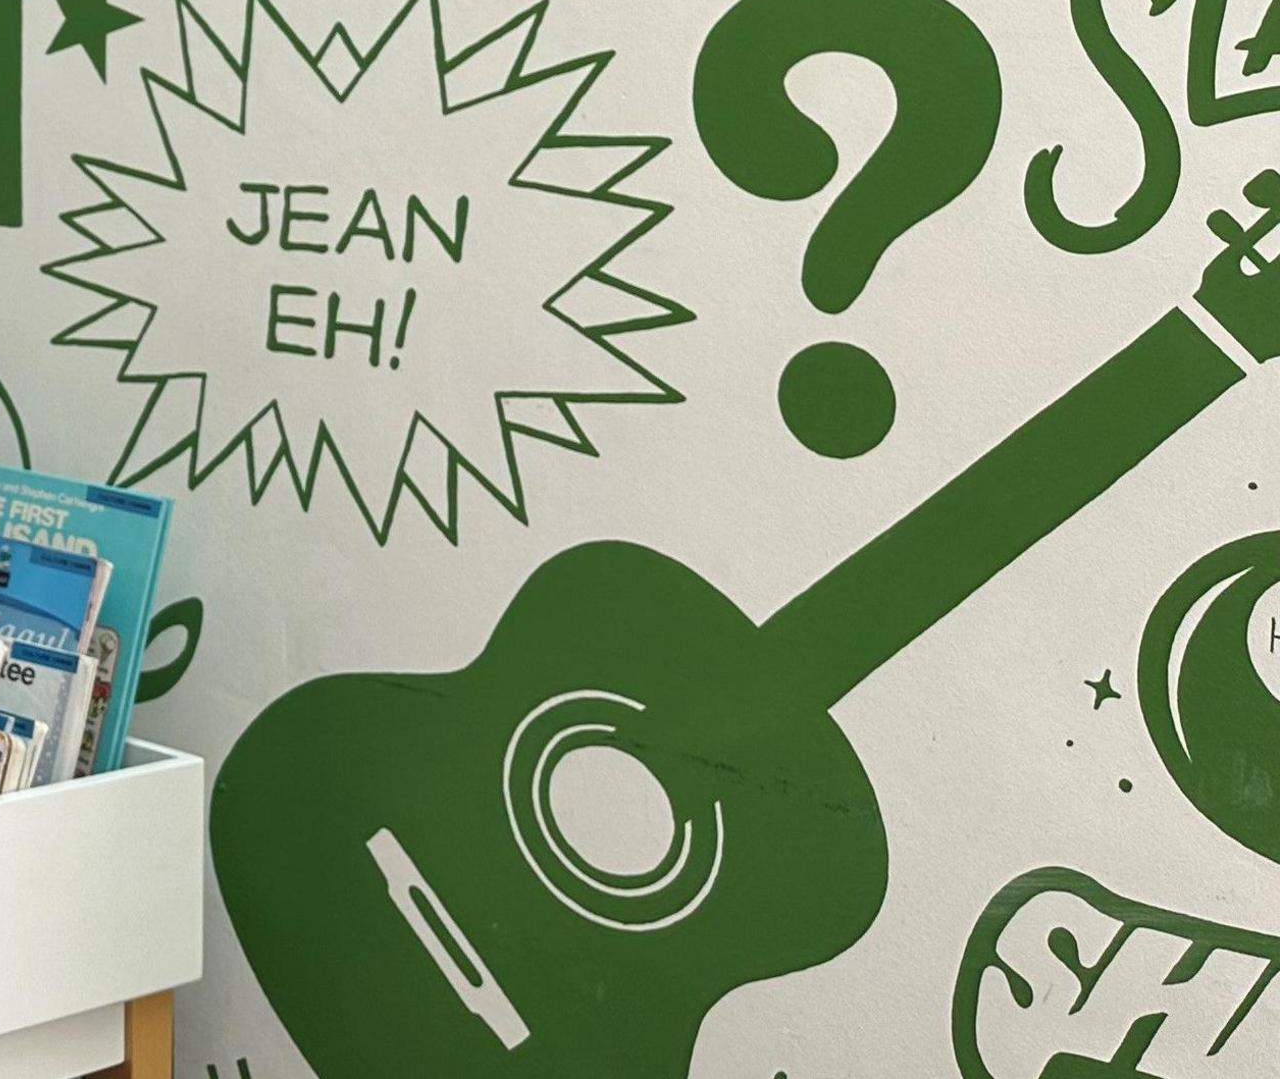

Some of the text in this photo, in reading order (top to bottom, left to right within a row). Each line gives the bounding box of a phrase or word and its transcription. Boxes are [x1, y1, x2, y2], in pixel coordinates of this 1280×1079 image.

[226, 182, 469, 263] JEAN
[266, 283, 417, 370] EH!
[9, 500, 70, 530] FIRST
